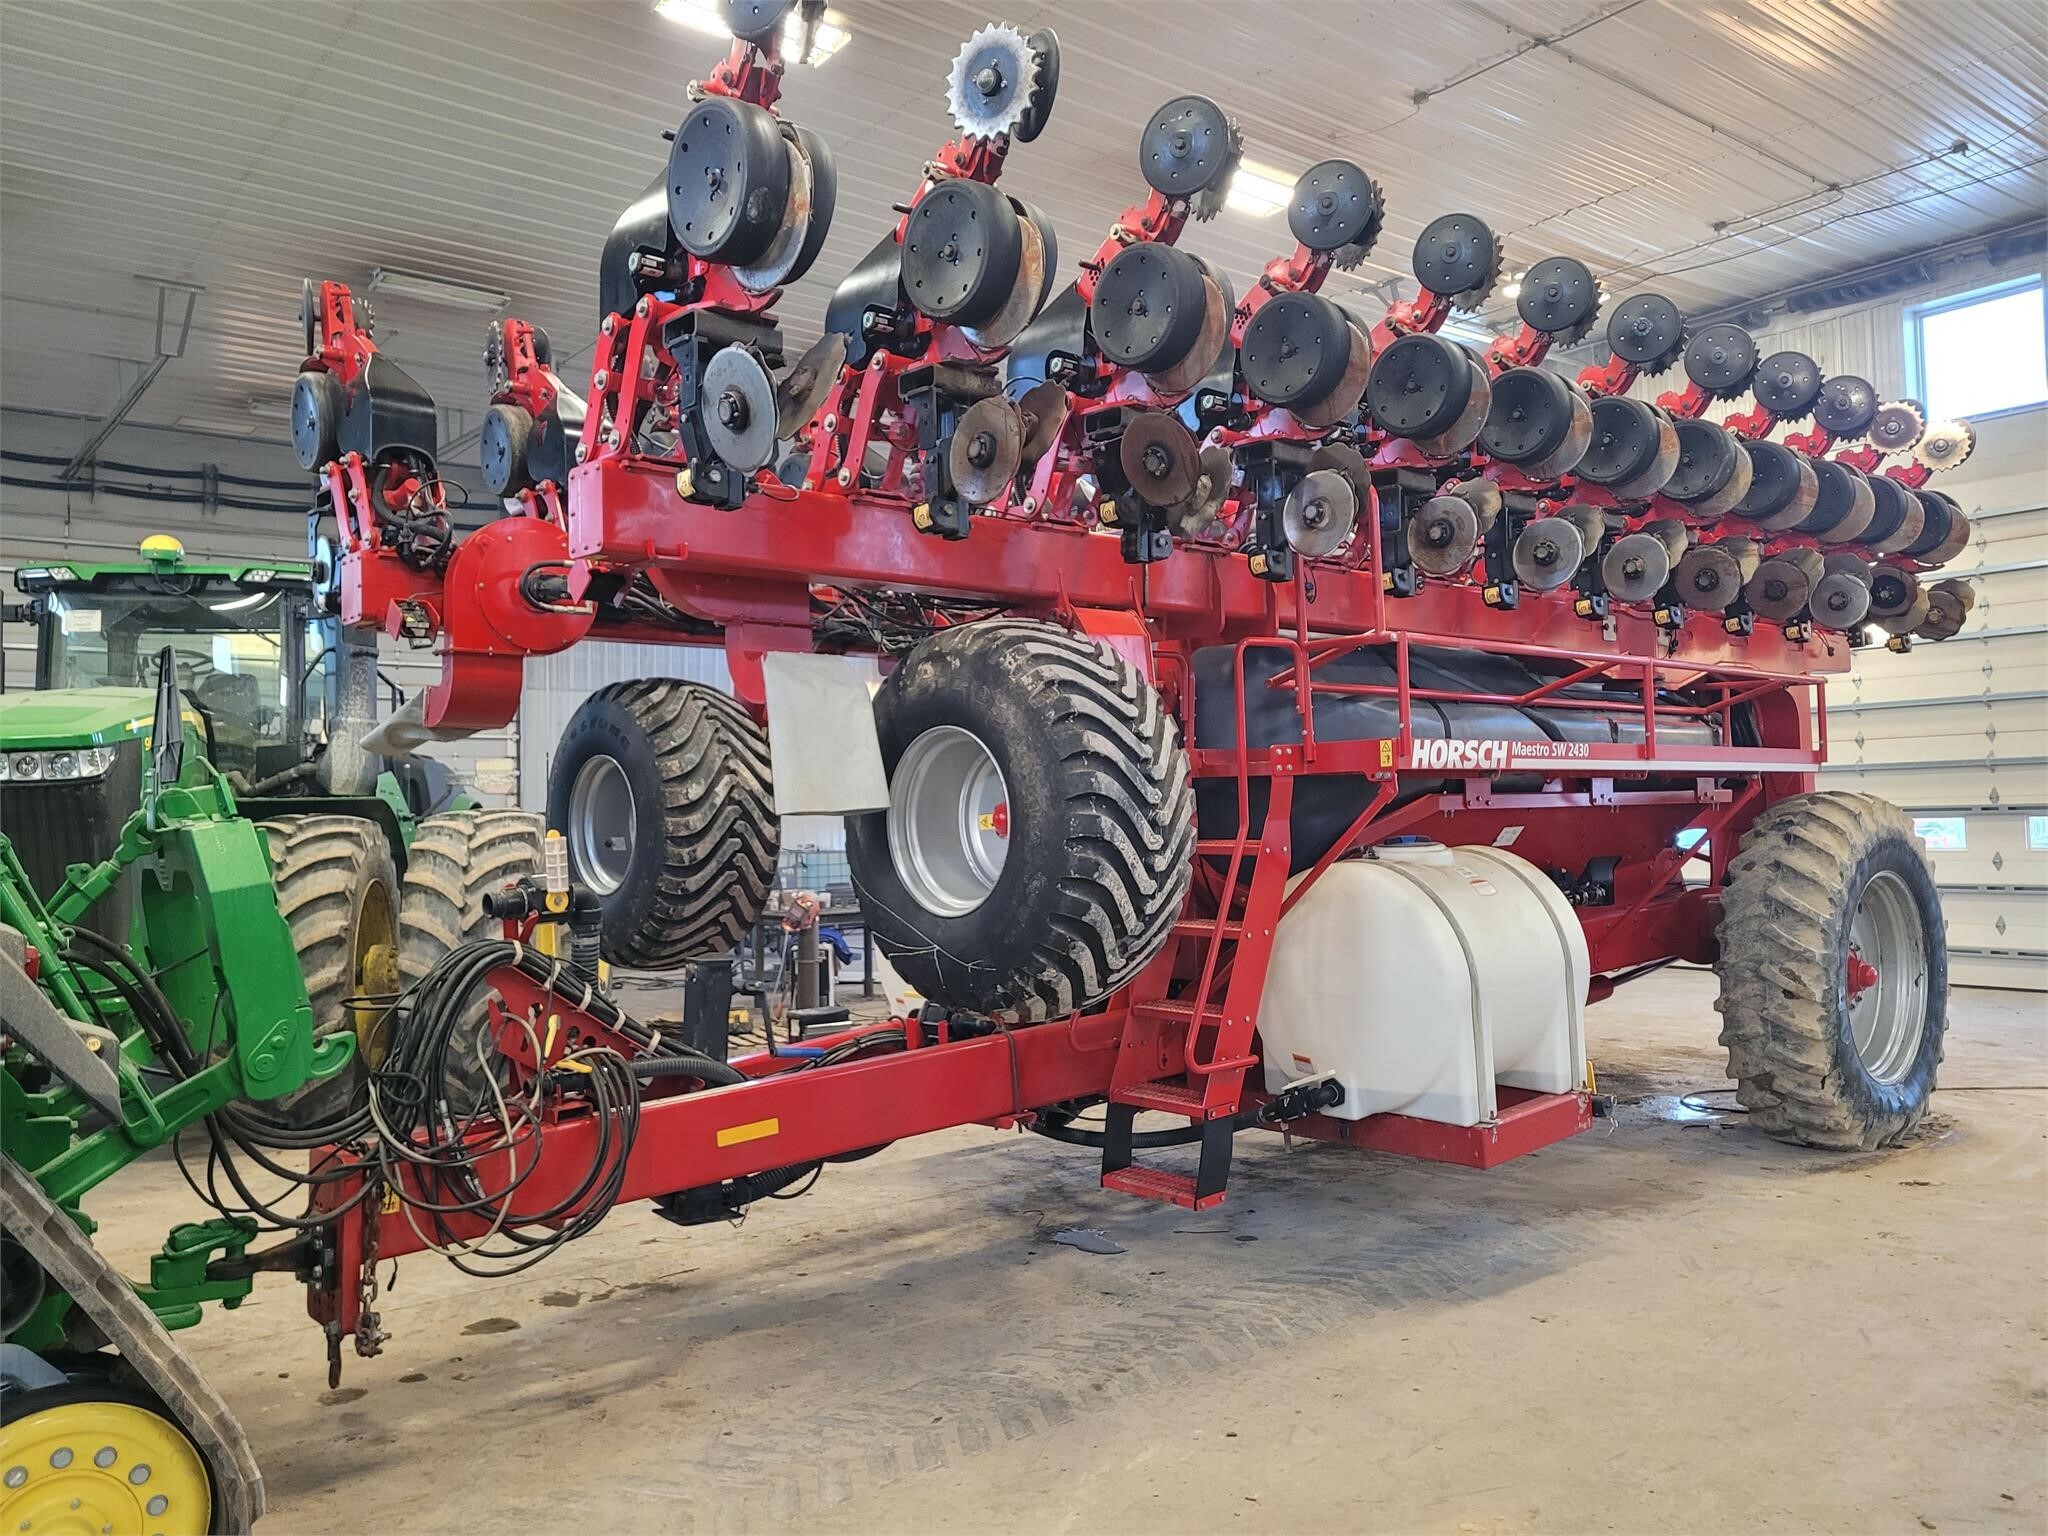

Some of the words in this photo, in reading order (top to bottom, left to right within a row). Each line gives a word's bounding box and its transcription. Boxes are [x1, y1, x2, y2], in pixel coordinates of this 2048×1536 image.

[1411, 739, 1509, 769] HORSCH
[1512, 741, 1550, 756] Maestro
[1552, 742, 1568, 757] SW
[1568, 743, 1590, 758] 2430
